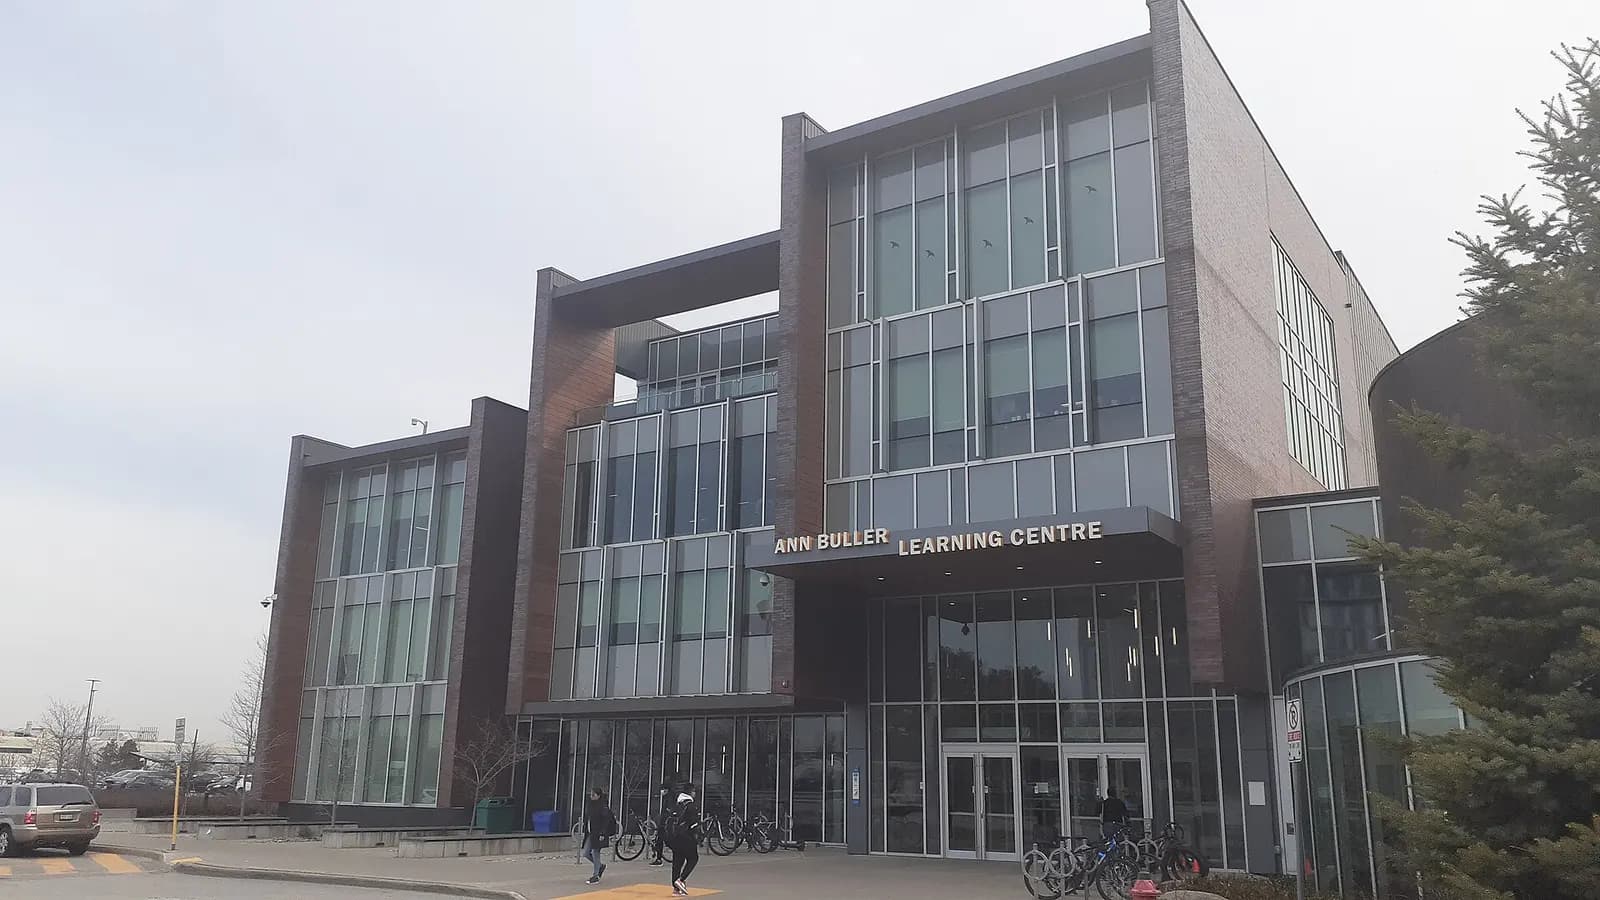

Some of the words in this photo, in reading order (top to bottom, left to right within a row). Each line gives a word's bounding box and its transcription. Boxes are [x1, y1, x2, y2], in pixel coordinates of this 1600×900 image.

[774, 535, 811, 554] ANN
[817, 527, 889, 550] BULLER
[898, 530, 1002, 556] LEARNING
[1010, 521, 1102, 546] CENTRE
